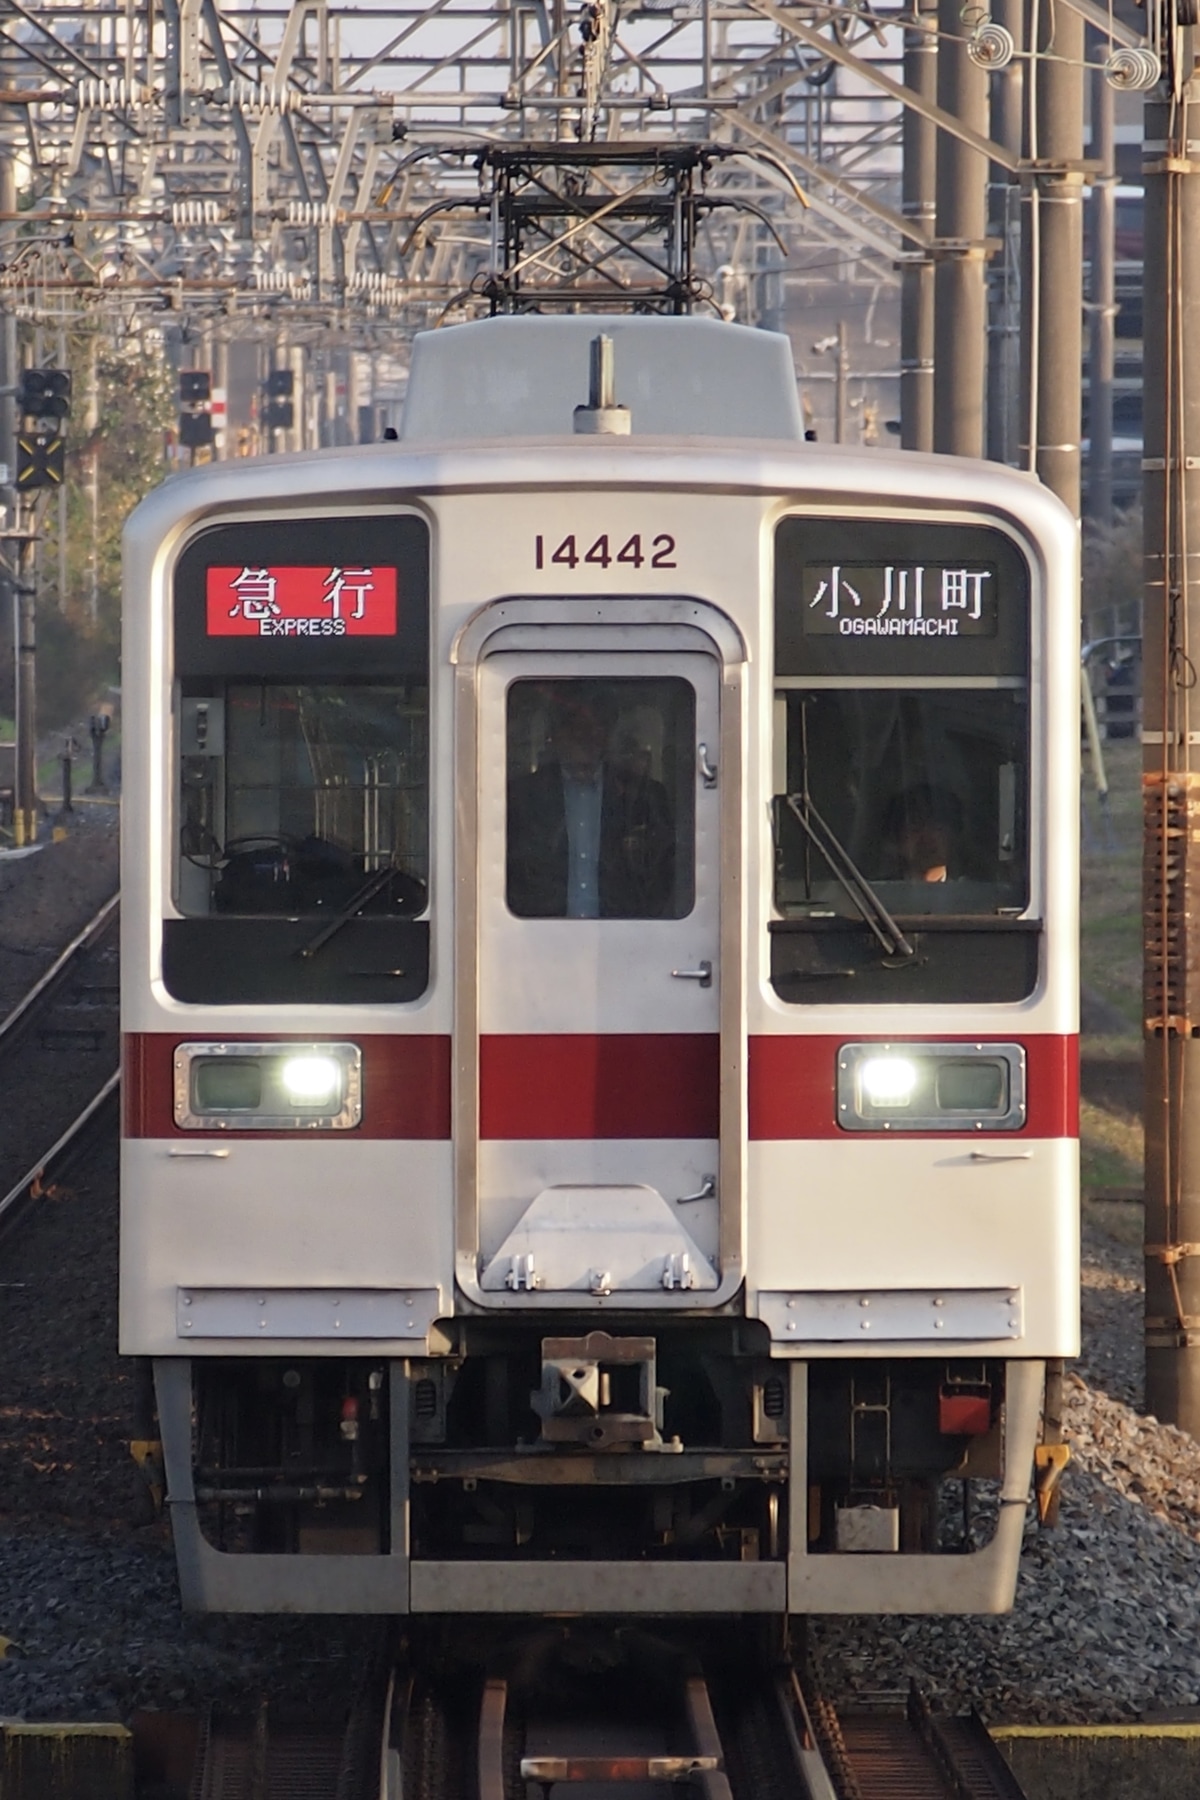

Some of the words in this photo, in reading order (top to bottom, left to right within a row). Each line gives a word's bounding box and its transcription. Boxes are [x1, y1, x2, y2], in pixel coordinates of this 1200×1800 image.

[535, 534, 677, 570] 14442
[228, 566, 374, 619] 急行
[809, 566, 992, 619] 小川町
[259, 619, 345, 636] EXPRESS
[839, 618, 959, 636] OGAWAMACHI
